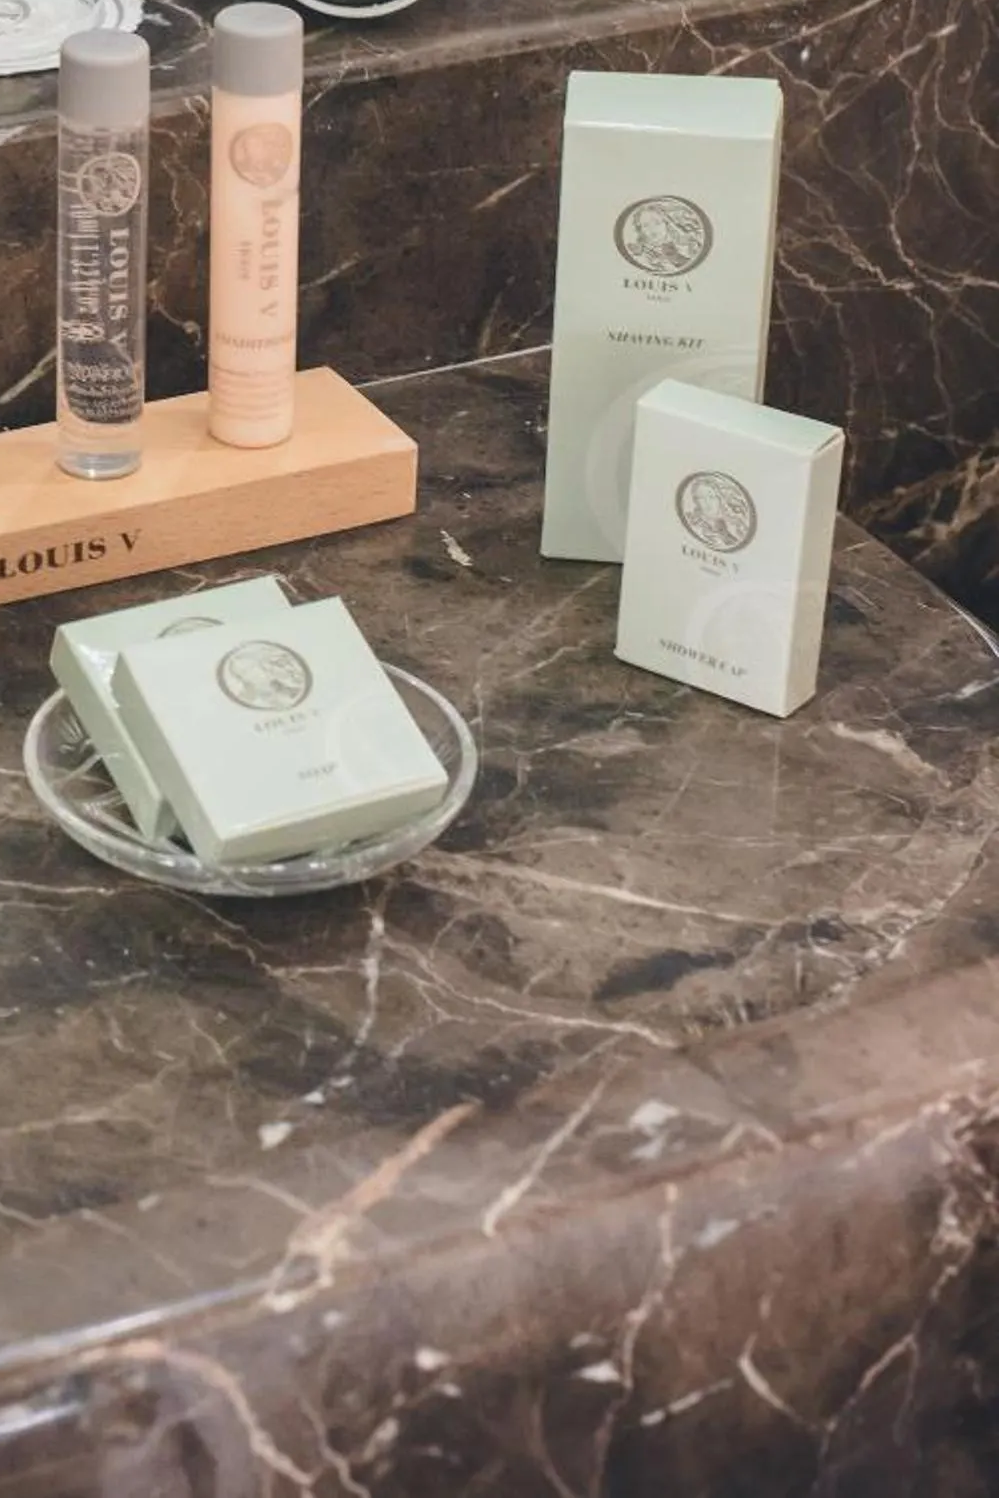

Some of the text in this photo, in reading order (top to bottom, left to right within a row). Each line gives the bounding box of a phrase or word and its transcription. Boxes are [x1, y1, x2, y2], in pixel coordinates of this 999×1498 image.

[259, 199, 283, 318] LOUIS V
[108, 227, 130, 349] LOUIS V
[622, 278, 679, 293] LOUIS
[121, 529, 142, 553] V
[681, 544, 727, 567] LOUIS
